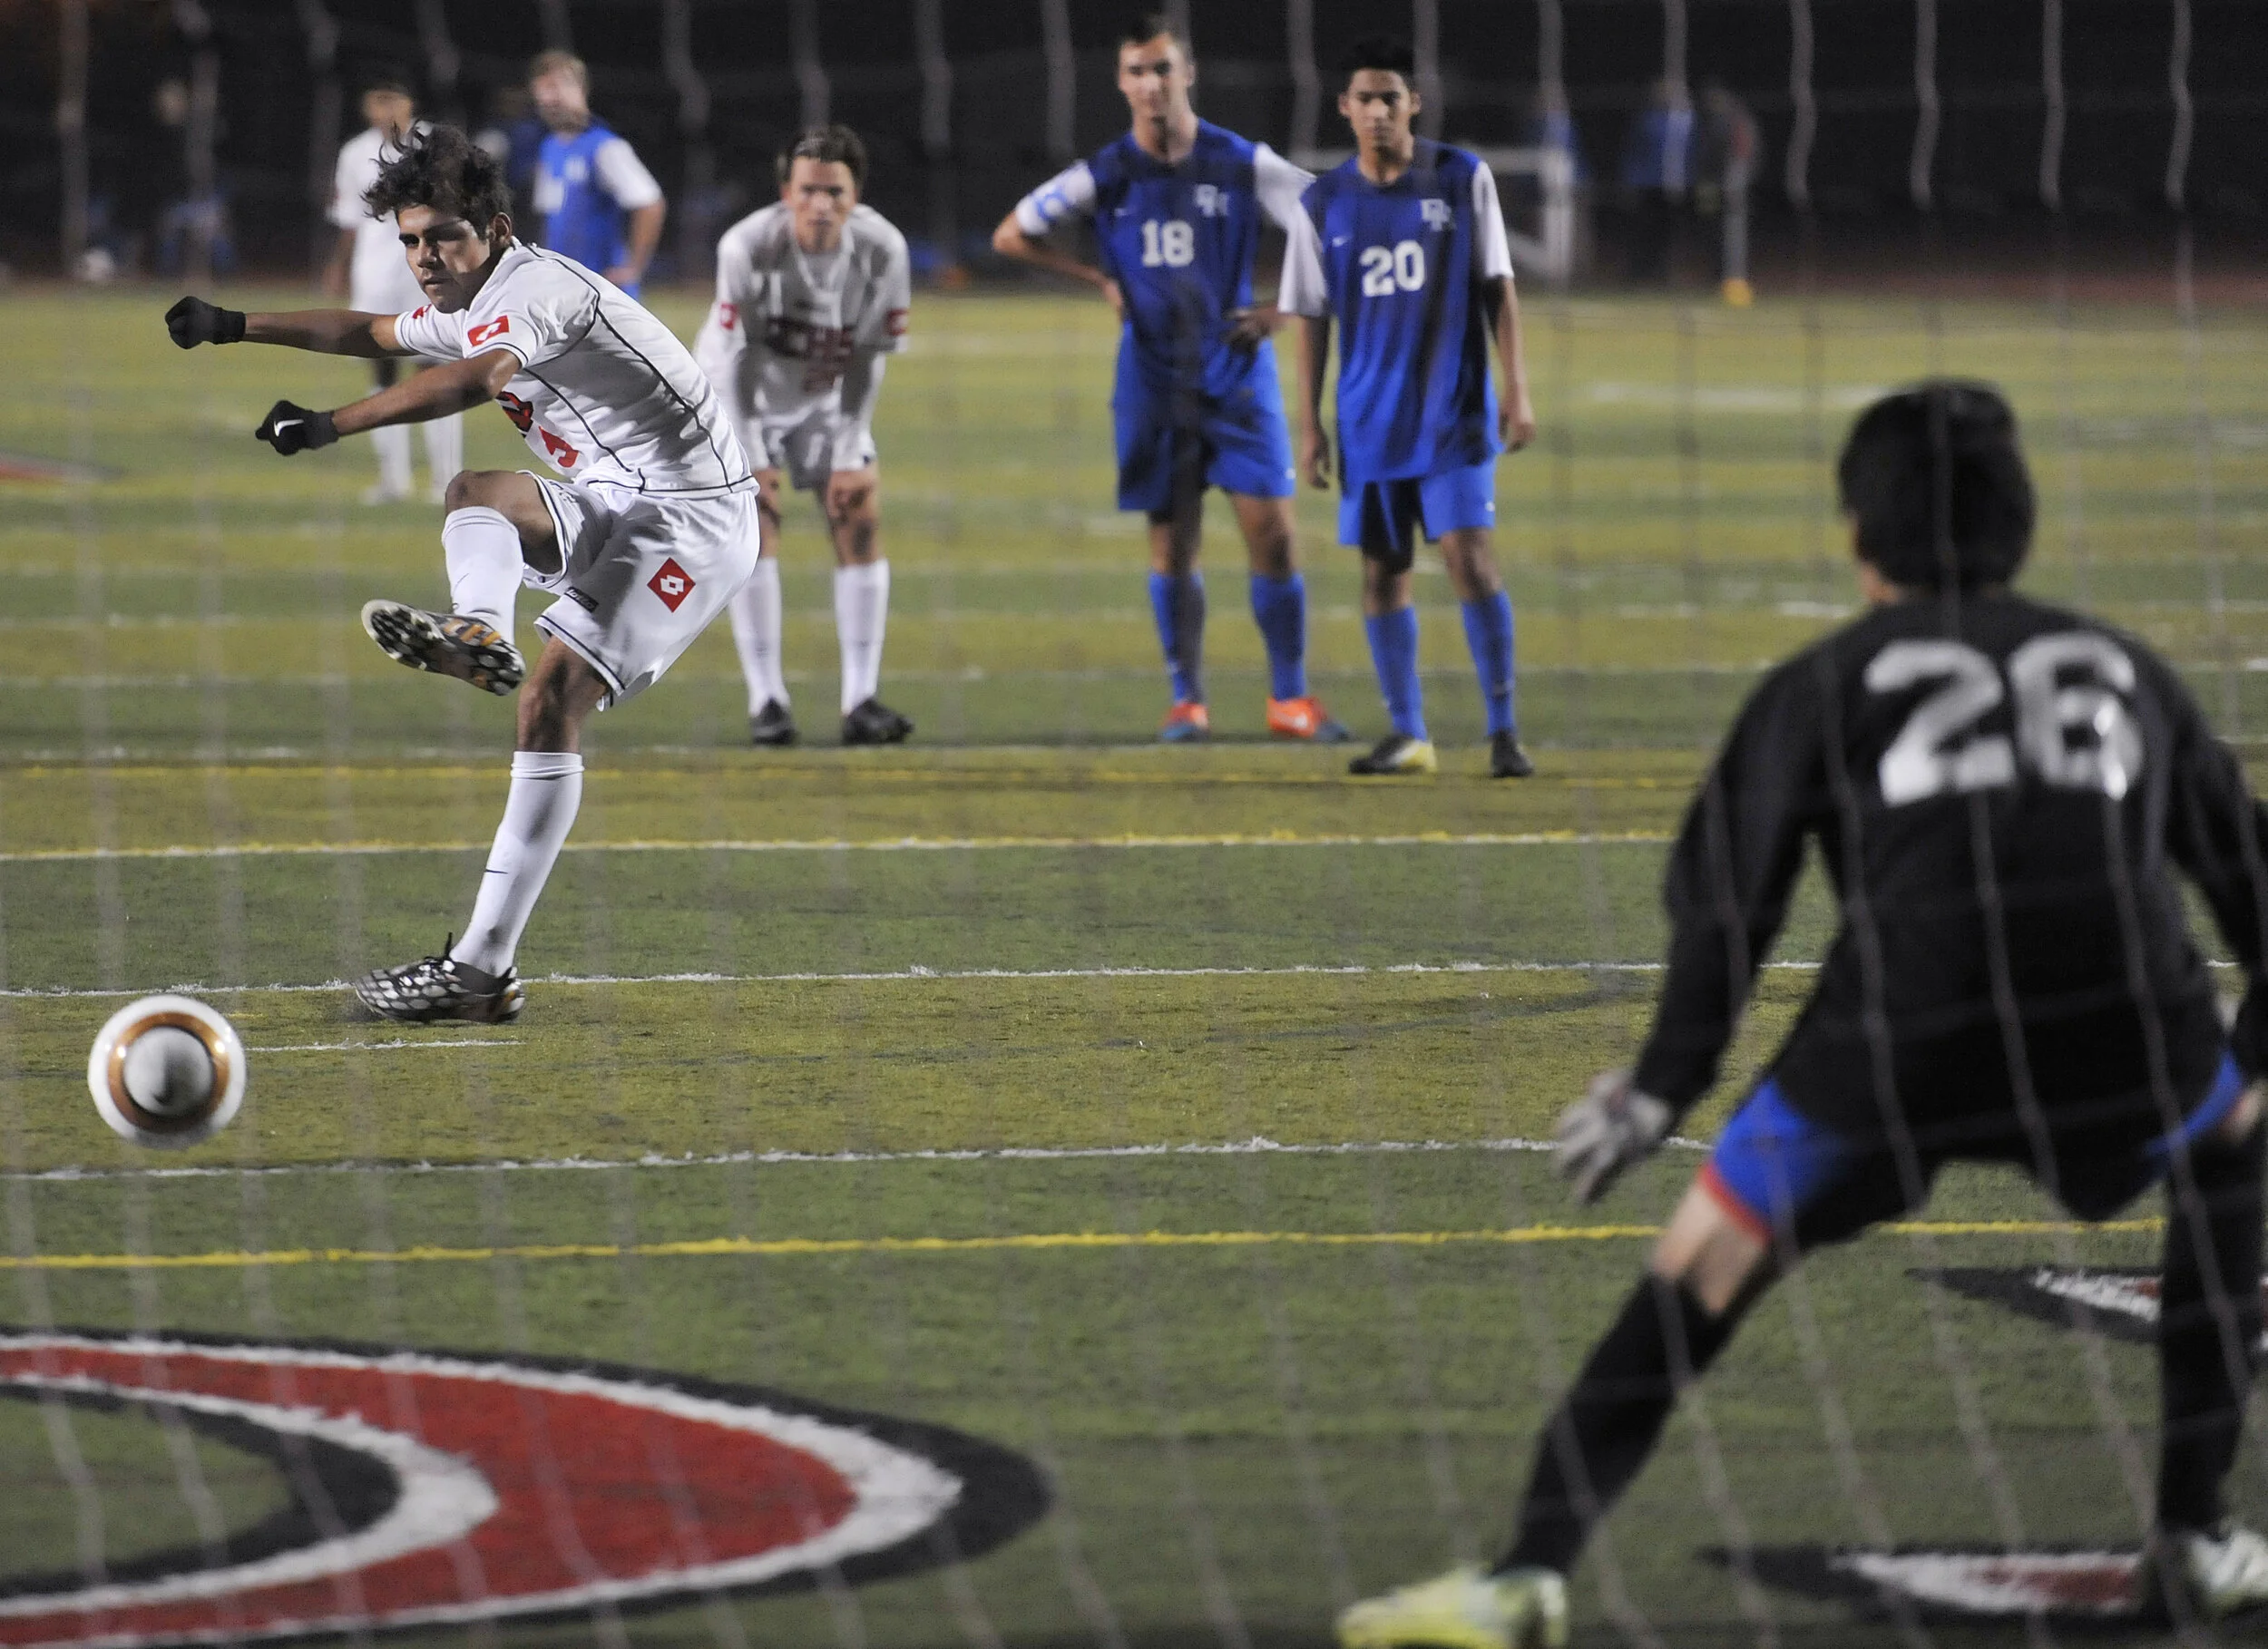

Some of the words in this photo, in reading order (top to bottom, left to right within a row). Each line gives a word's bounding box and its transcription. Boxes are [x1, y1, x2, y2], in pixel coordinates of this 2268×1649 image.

[1141, 218, 1194, 268] 18
[1359, 239, 1425, 297] 20
[1864, 629, 2144, 807] 26
